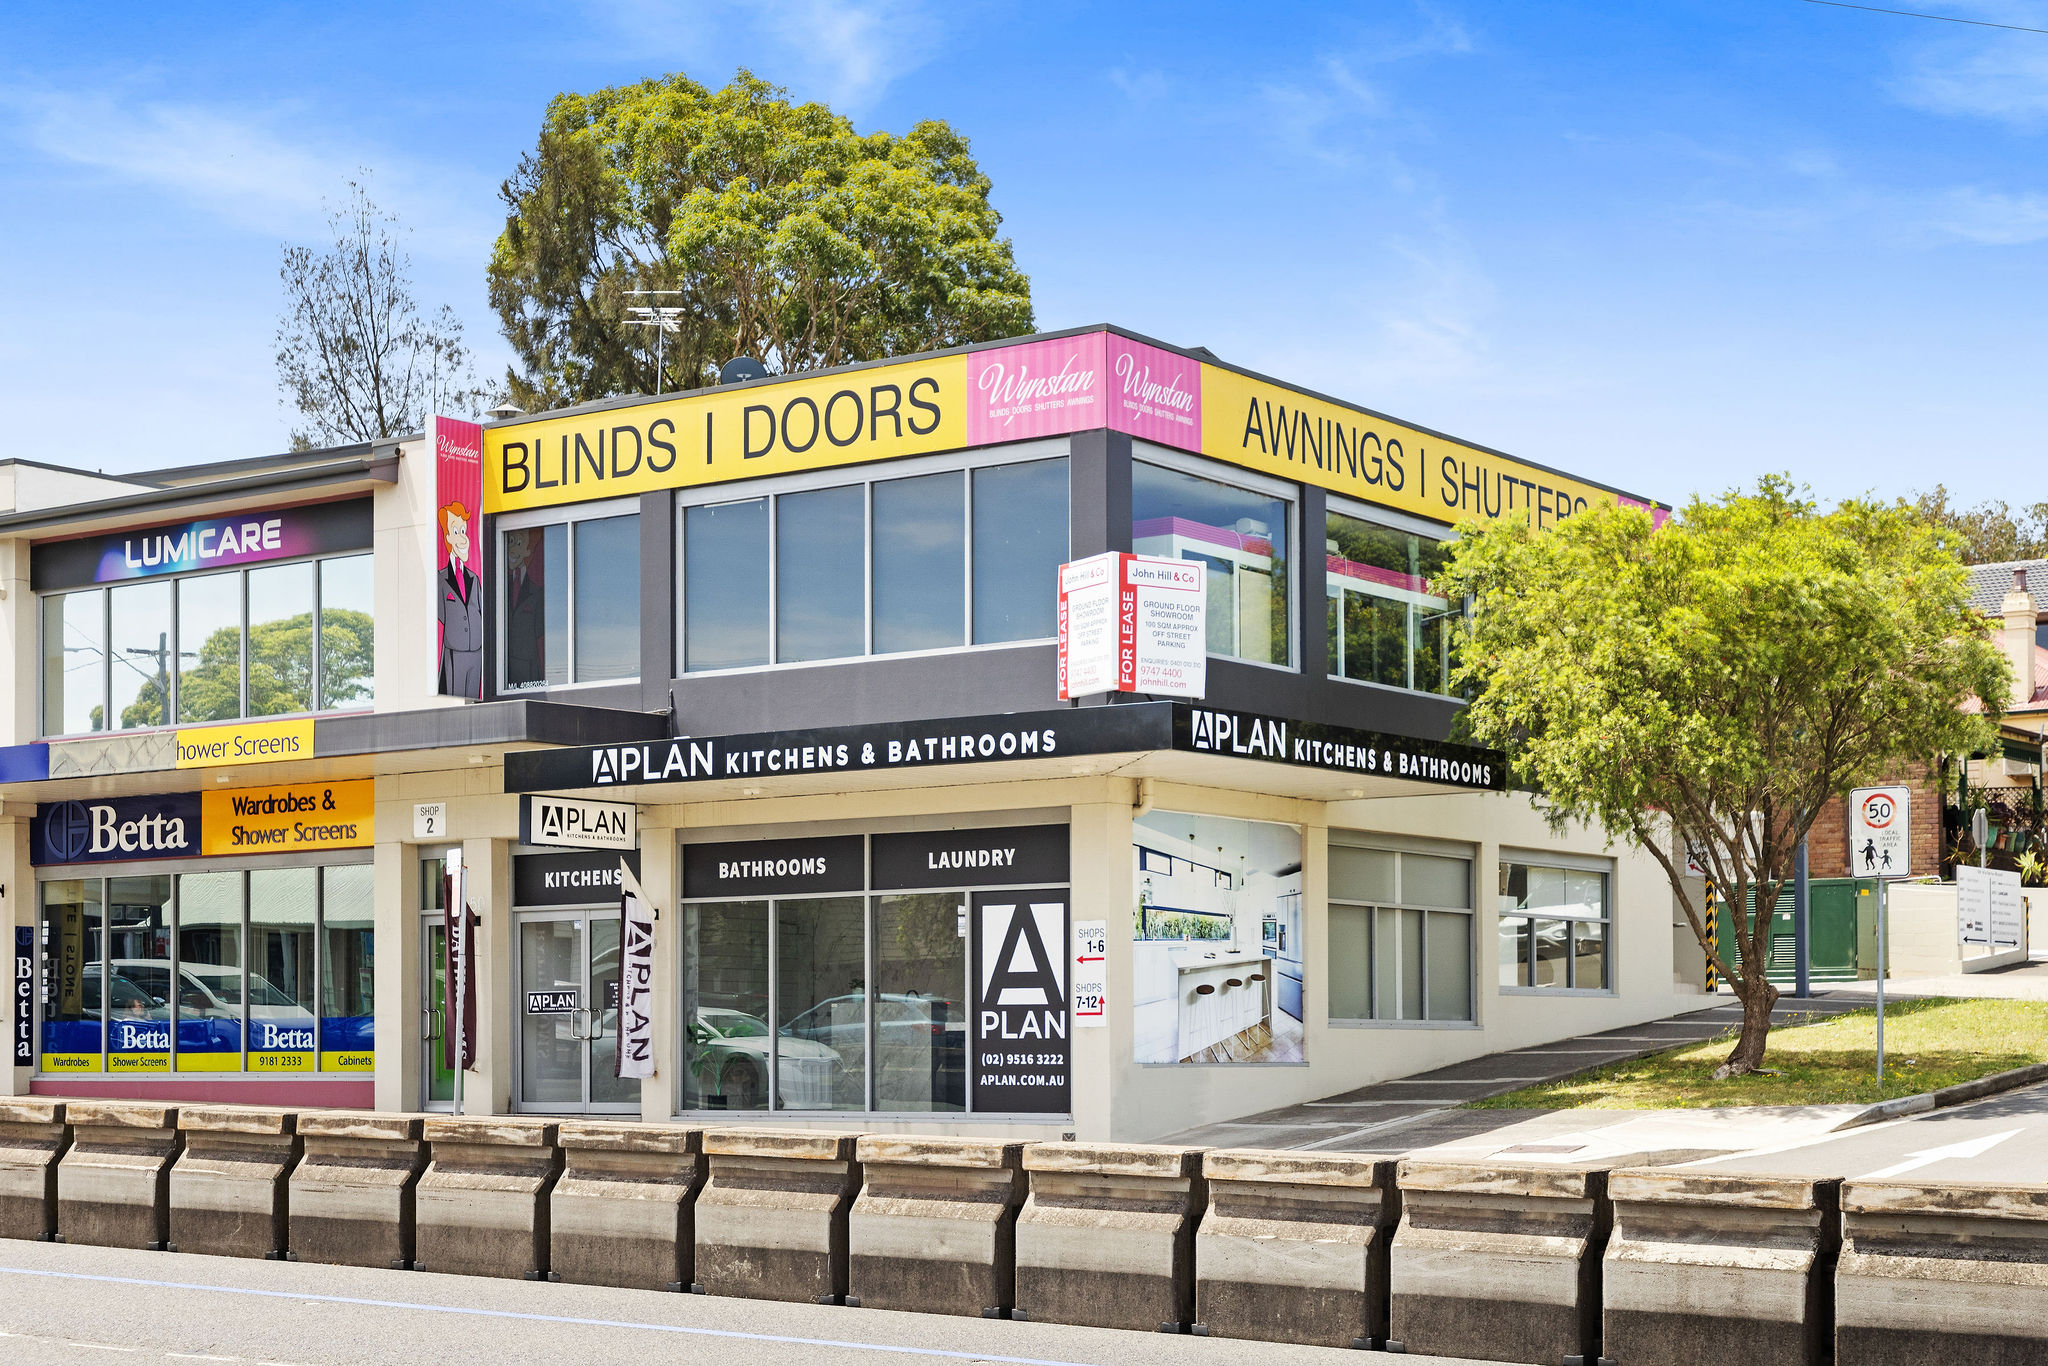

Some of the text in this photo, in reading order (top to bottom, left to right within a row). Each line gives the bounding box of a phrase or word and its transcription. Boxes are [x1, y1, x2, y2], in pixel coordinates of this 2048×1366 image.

[978, 353, 1095, 427] Wynstan
[1115, 353, 1194, 421] Wynstan
[989, 407, 1010, 418] BLINDS
[1035, 399, 1064, 412] SHUTTERS
[503, 417, 677, 494] BLINDS
[743, 377, 941, 460] DOORS
[1242, 396, 1405, 492] AWNINGS
[125, 518, 282, 569] LUMICARE
[1132, 567, 1195, 583] John Hill & Co
[1143, 600, 1201, 613] GROUND FLOOR
[1150, 610, 1194, 621] SHOWROOM
[1152, 630, 1191, 641] OFF STREET
[1157, 622, 1172, 631] SQM
[1172, 624, 1198, 632] APPROX
[1060, 600, 1068, 692] FOR LEASE
[1121, 591, 1134, 684] FOR LEASE
[1157, 640, 1186, 649] PARKING
[1140, 666, 1183, 678] 9747 4400
[1140, 676, 1187, 689] johnhill.com
[176, 734, 300, 761] hower Screens
[592, 730, 1056, 783] APLAN KITCHENS & BATHROOMS
[1192, 710, 1491, 785] APLAN KITCHENS & BATHROOMS
[232, 789, 336, 817] Wardrobes &
[420, 806, 440, 816] SHOP
[1869, 803, 1891, 819] 50
[89, 805, 189, 854] Betta
[426, 817, 434, 834] 2
[541, 805, 626, 837] APLAN
[232, 822, 357, 846] Shower Screens
[928, 848, 1016, 869] LAUNDRY
[719, 857, 827, 880] BATHROOMS
[545, 868, 622, 888] KITCHENS
[1078, 928, 1105, 939] SHOPS
[1087, 939, 1105, 953] 1-6
[1075, 983, 1102, 993] SHOPS
[16, 957, 33, 1057] Betta
[529, 994, 575, 1011] APLAN
[1076, 995, 1097, 1009] 7-12
[980, 1010, 1065, 1040] PLAN
[122, 1025, 170, 1049] Betta
[263, 1024, 315, 1049] Betta
[53, 1057, 90, 1067] Wardrobes
[112, 1057, 167, 1067] Shower Screens
[259, 1056, 302, 1066] 9181 2333
[338, 1056, 372, 1066] Cabinets
[981, 1053, 1064, 1068] (02) 9516 3222
[980, 1073, 1065, 1087] APLAN.COM.AU
